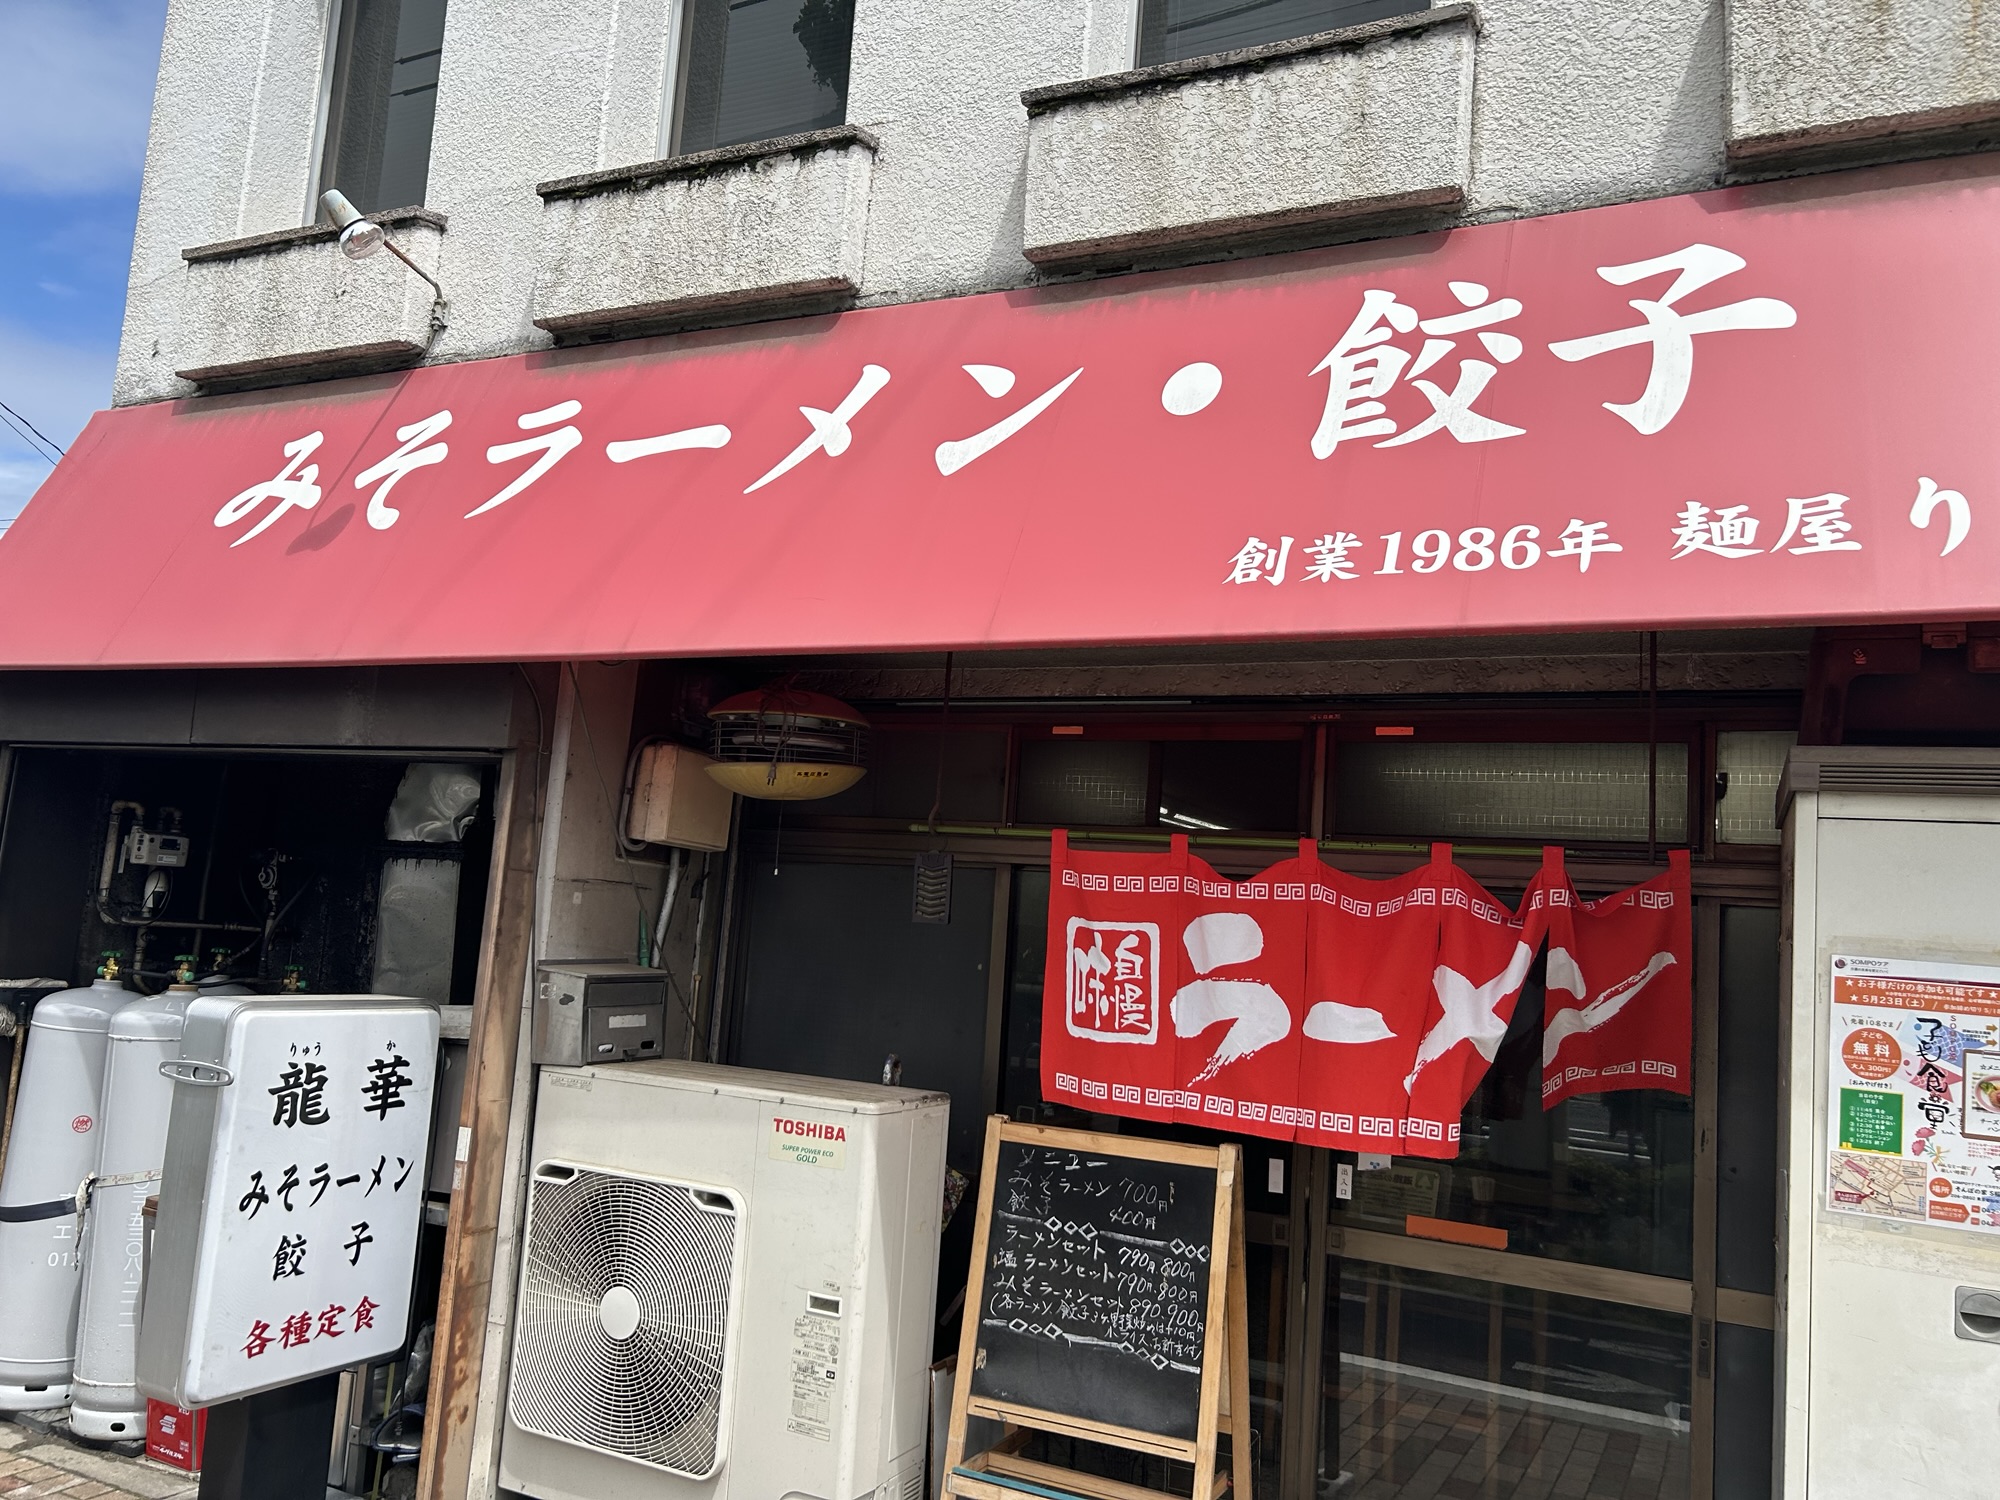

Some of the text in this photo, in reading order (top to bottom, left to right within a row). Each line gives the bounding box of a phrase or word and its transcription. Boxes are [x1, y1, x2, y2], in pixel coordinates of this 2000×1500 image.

[1222, 476, 1971, 587] 創業1986年 麺屋 り
[1850, 959, 1889, 967] SOMPOケア
[1857, 979, 1985, 998] お子様だけの参加も可能です
[1170, 912, 1677, 1097] ラーメン
[1851, 1018, 1894, 1028] 先着10名さま
[1861, 1031, 1883, 1040] 子ども
[290, 1040, 397, 1057] りゅう か
[1853, 1041, 1890, 1058] 無料
[1851, 1063, 1866, 1071] 大人
[268, 1055, 413, 1129] 龍華
[773, 1117, 846, 1142] TOSHIBA
[782, 1144, 799, 1152] SUPER
[800, 1147, 821, 1155] POWER
[796, 1154, 818, 1164] GOLD
[1018, 1148, 1109, 1170] メニュー
[239, 1155, 414, 1221] みそラーメン
[1008, 1170, 1168, 1212] みそラーメン 700円
[1340, 1167, 1349, 1196] 出入口
[1109, 1206, 1156, 1230] 400円
[271, 1221, 374, 1282] 餃子
[1006, 1224, 1106, 1260] ラーメンセット
[240, 1295, 381, 1360] 各種定食
